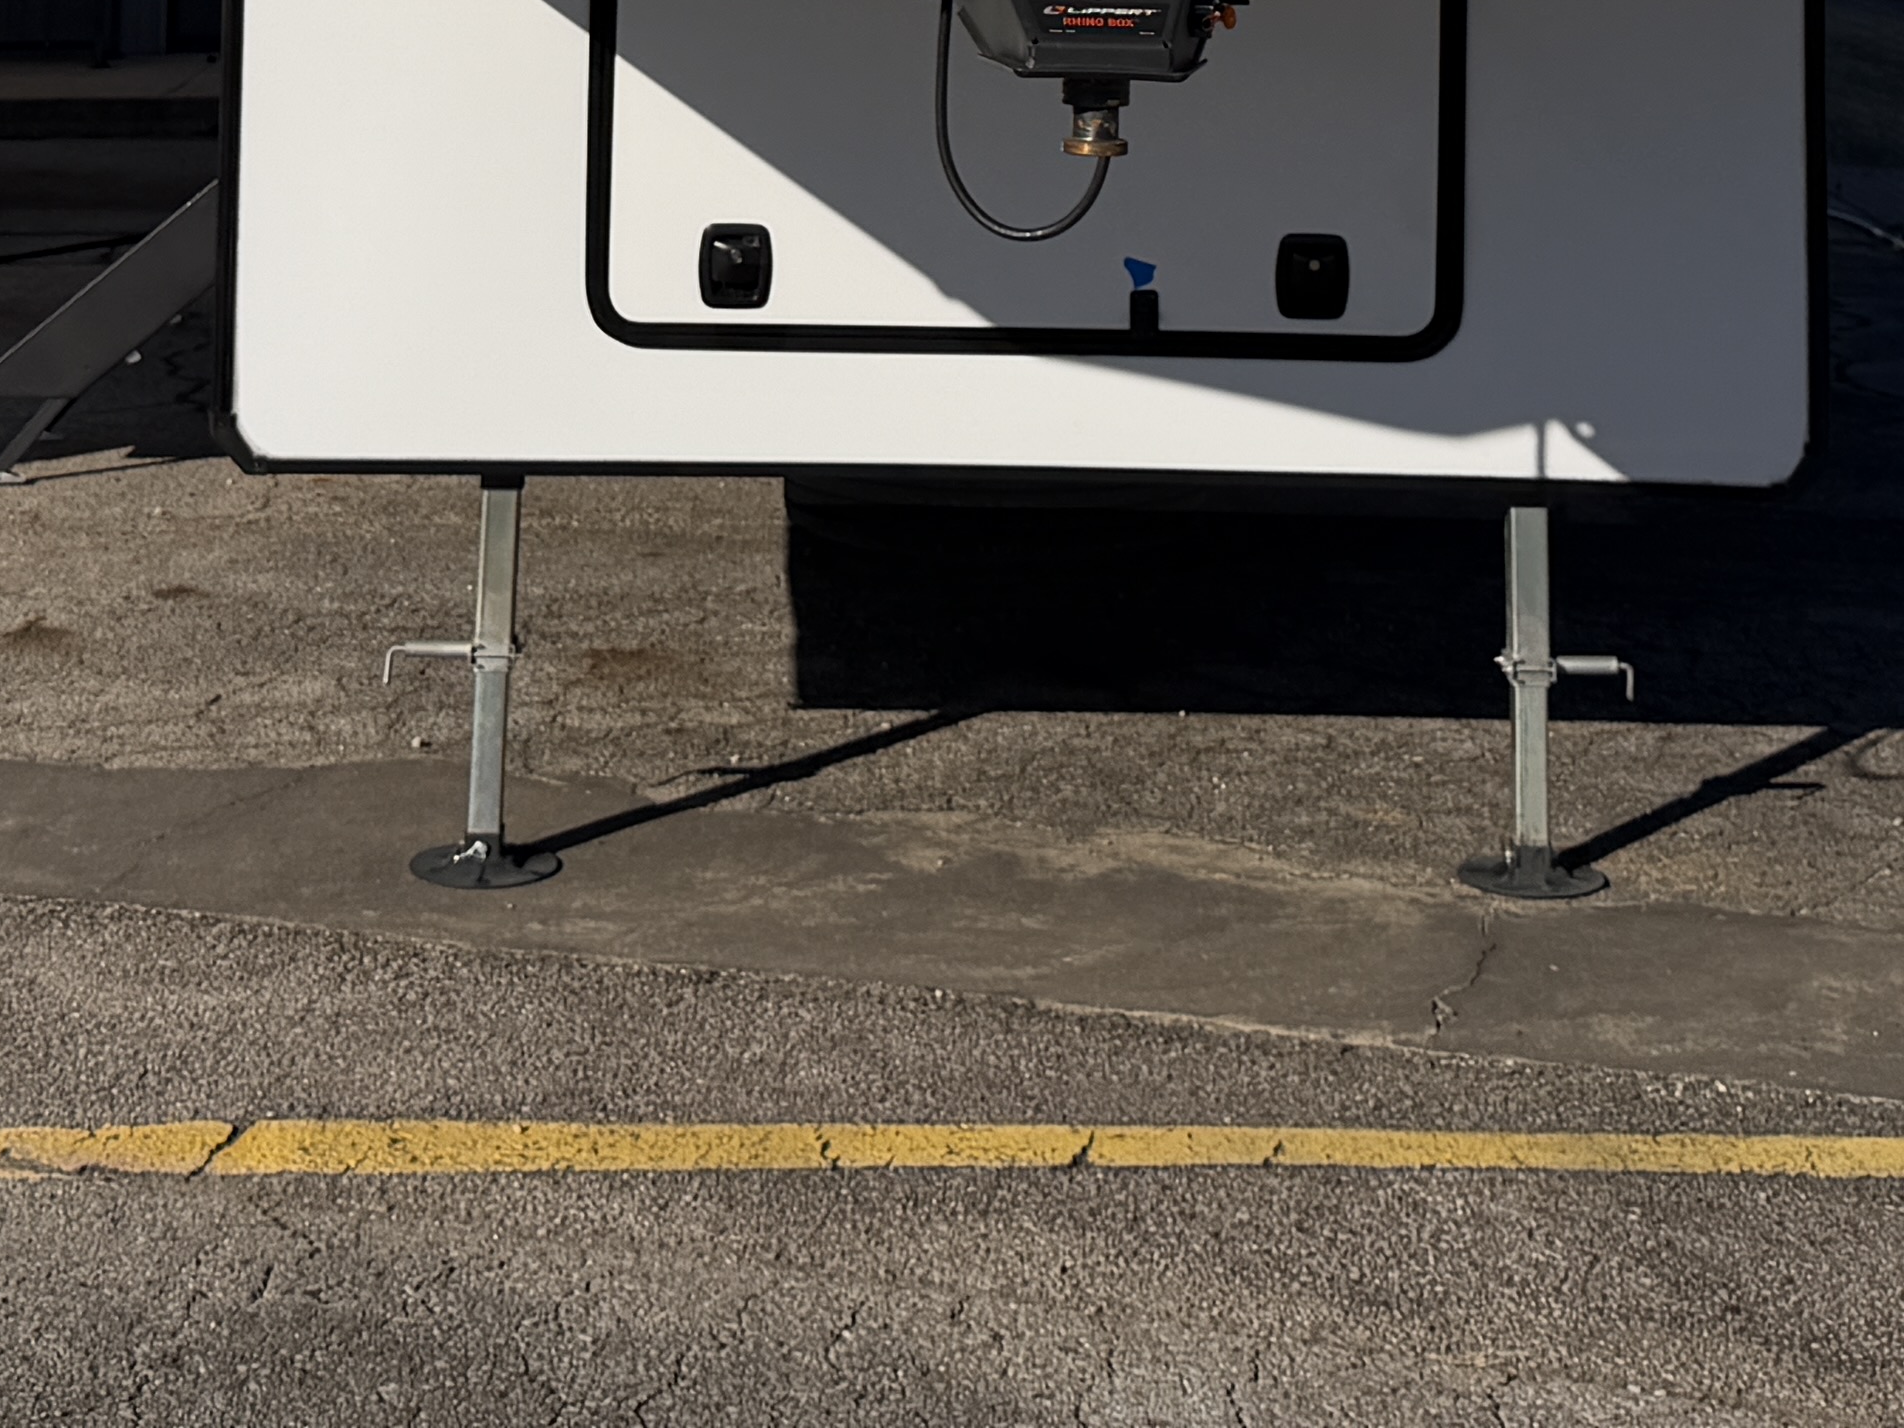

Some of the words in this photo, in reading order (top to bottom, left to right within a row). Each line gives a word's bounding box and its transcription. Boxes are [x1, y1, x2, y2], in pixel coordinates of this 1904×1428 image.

[1067, 7, 1158, 17] LIPPERT
[1062, 16, 1105, 27] RHINO
[1108, 17, 1135, 28] BOX
